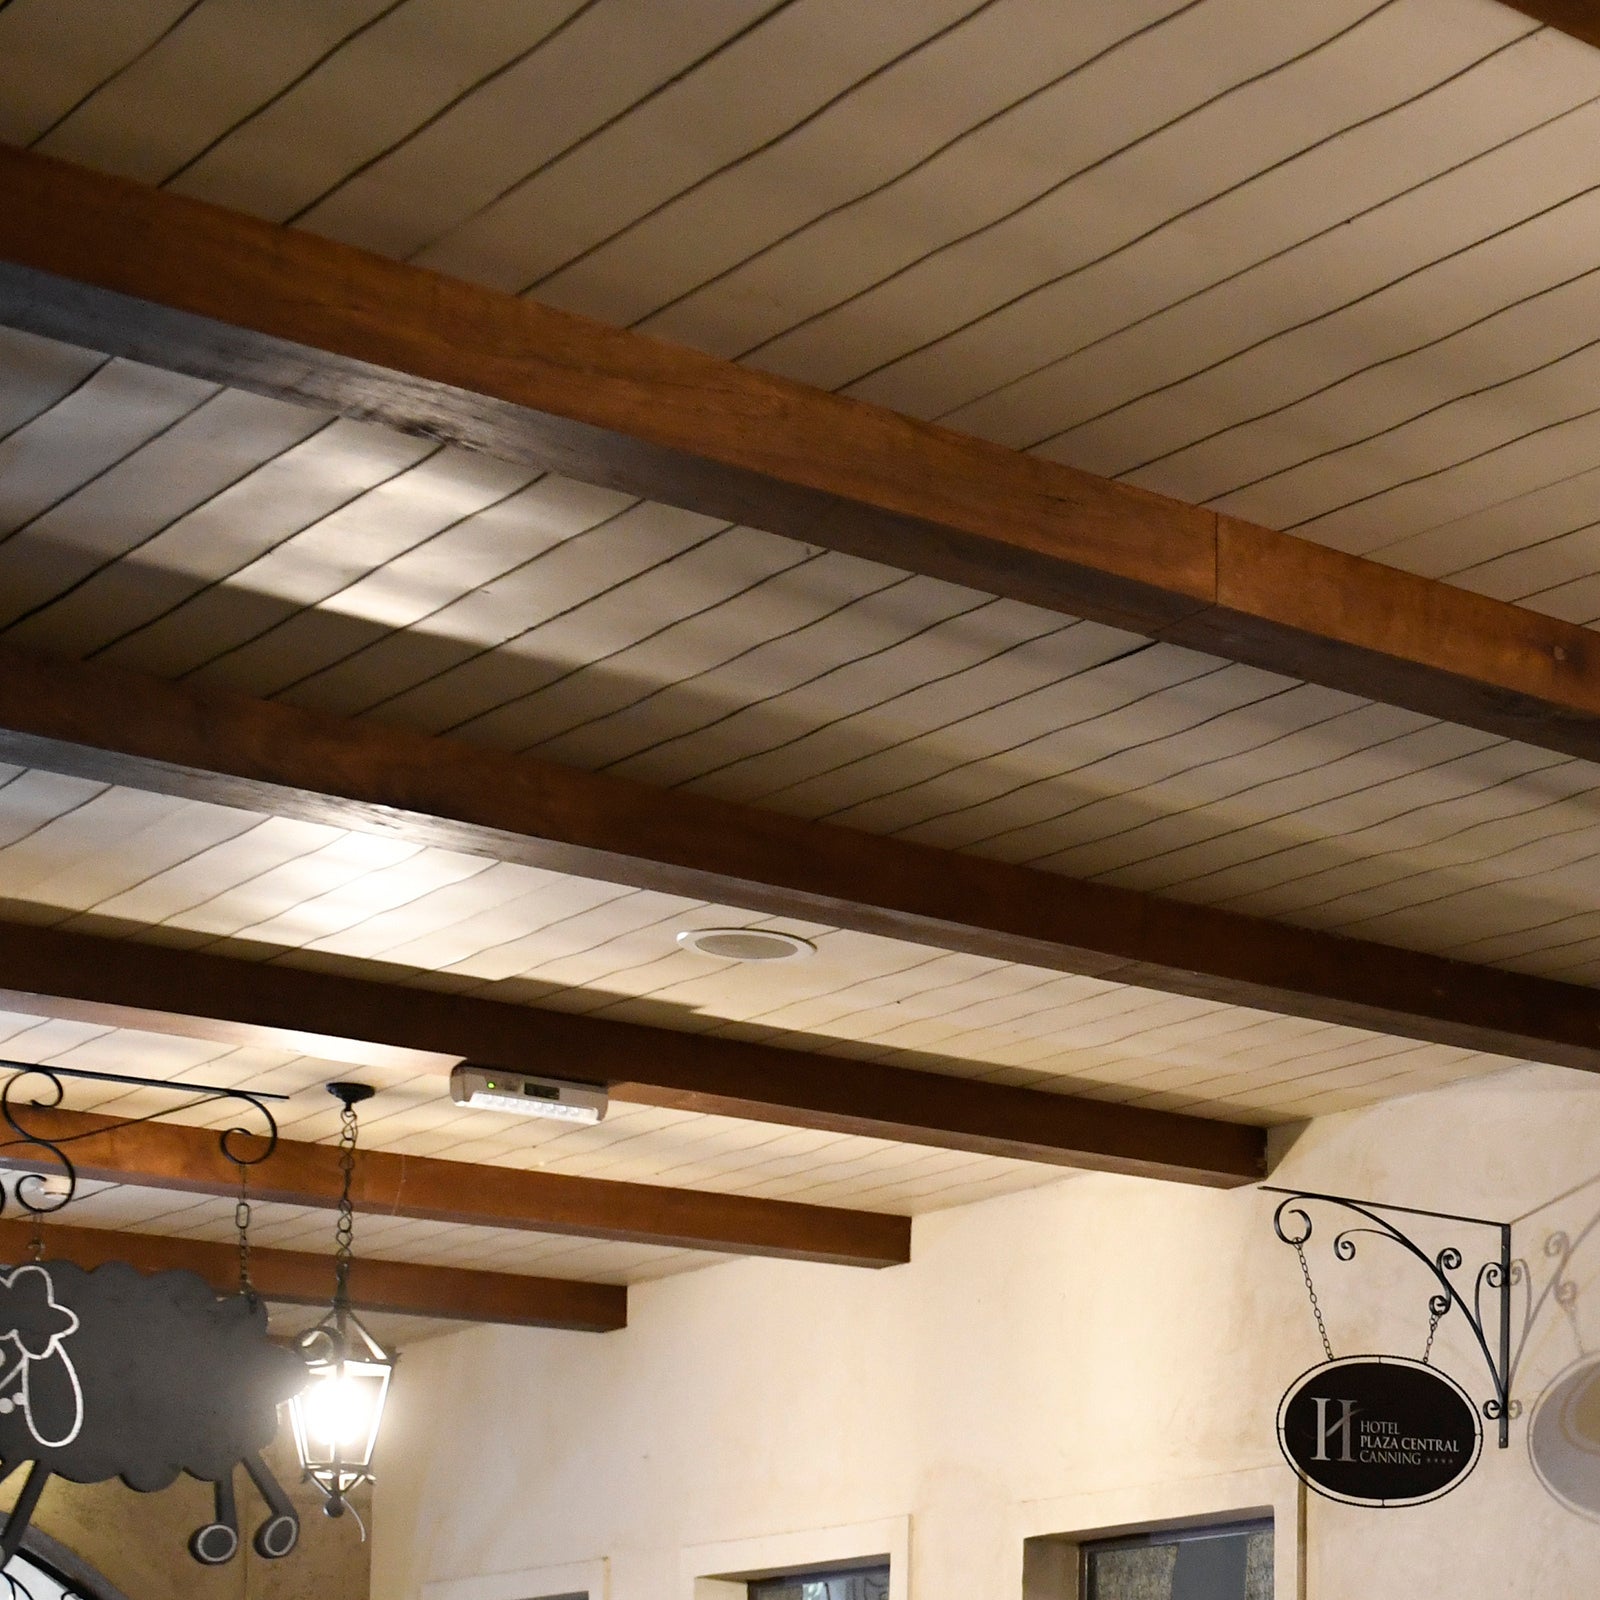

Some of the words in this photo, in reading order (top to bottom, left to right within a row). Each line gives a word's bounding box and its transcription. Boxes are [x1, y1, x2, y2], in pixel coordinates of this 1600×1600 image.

[1360, 1421, 1400, 1434] HOTEL
[1360, 1436, 1398, 1449] PLAZA
[1401, 1437, 1459, 1452] CENTRAL
[1359, 1451, 1421, 1465] CANNING
